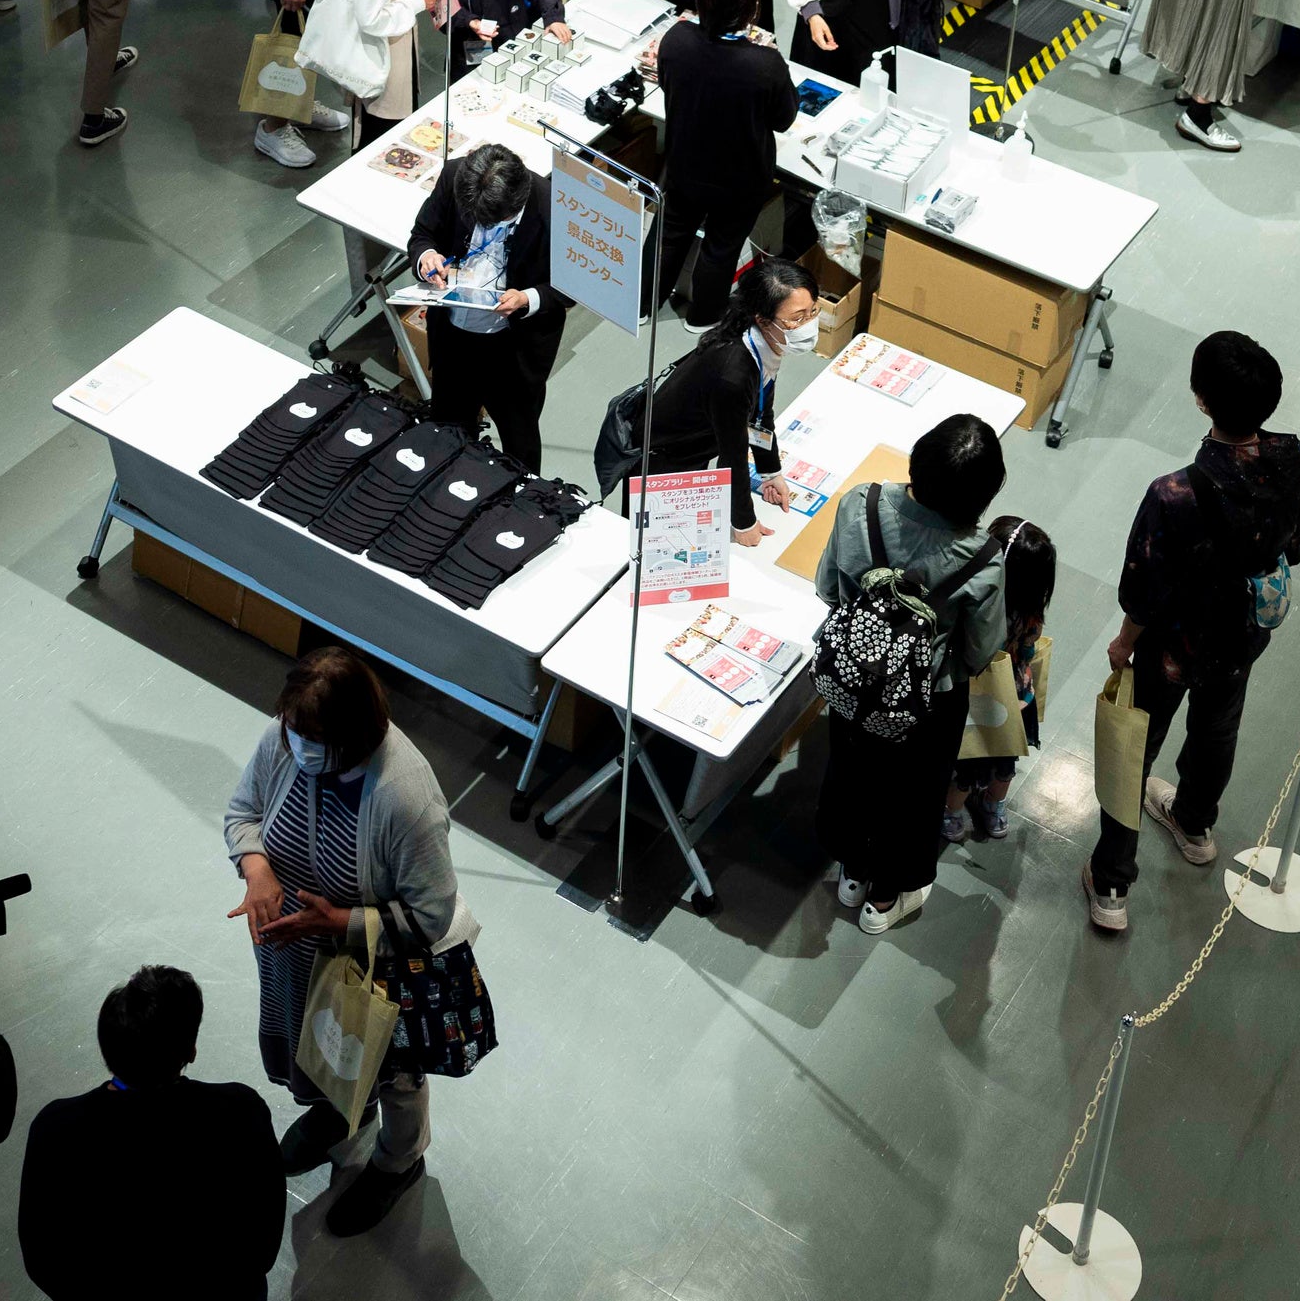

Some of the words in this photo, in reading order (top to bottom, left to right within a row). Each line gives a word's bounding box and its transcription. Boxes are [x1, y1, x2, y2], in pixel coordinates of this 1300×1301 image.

[556, 189, 637, 242] スタンプラリー
[566, 220, 625, 266] 景品交換
[566, 247, 623, 287] カウンター
